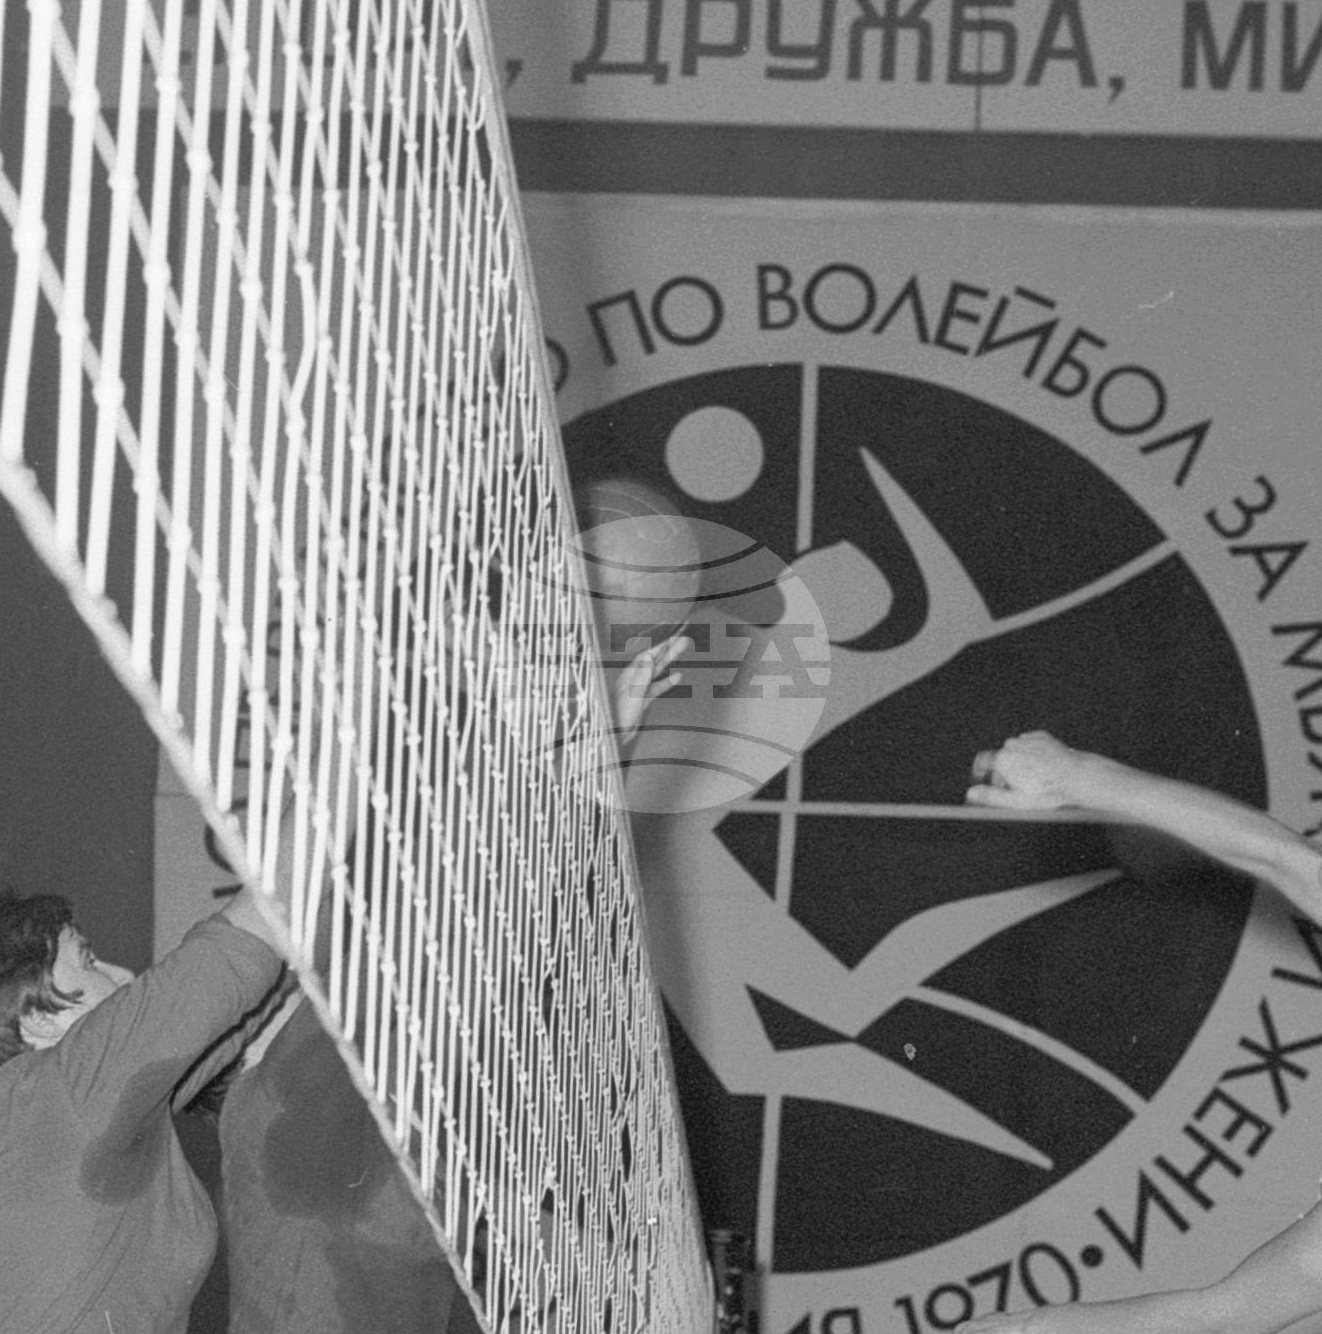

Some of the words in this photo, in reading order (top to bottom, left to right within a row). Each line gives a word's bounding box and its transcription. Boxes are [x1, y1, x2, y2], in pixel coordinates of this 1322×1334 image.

[585, 275, 724, 368] ПО
[755, 262, 1213, 488] ВОЛЕЙБОЛ
[1203, 474, 1311, 603] ЗА
